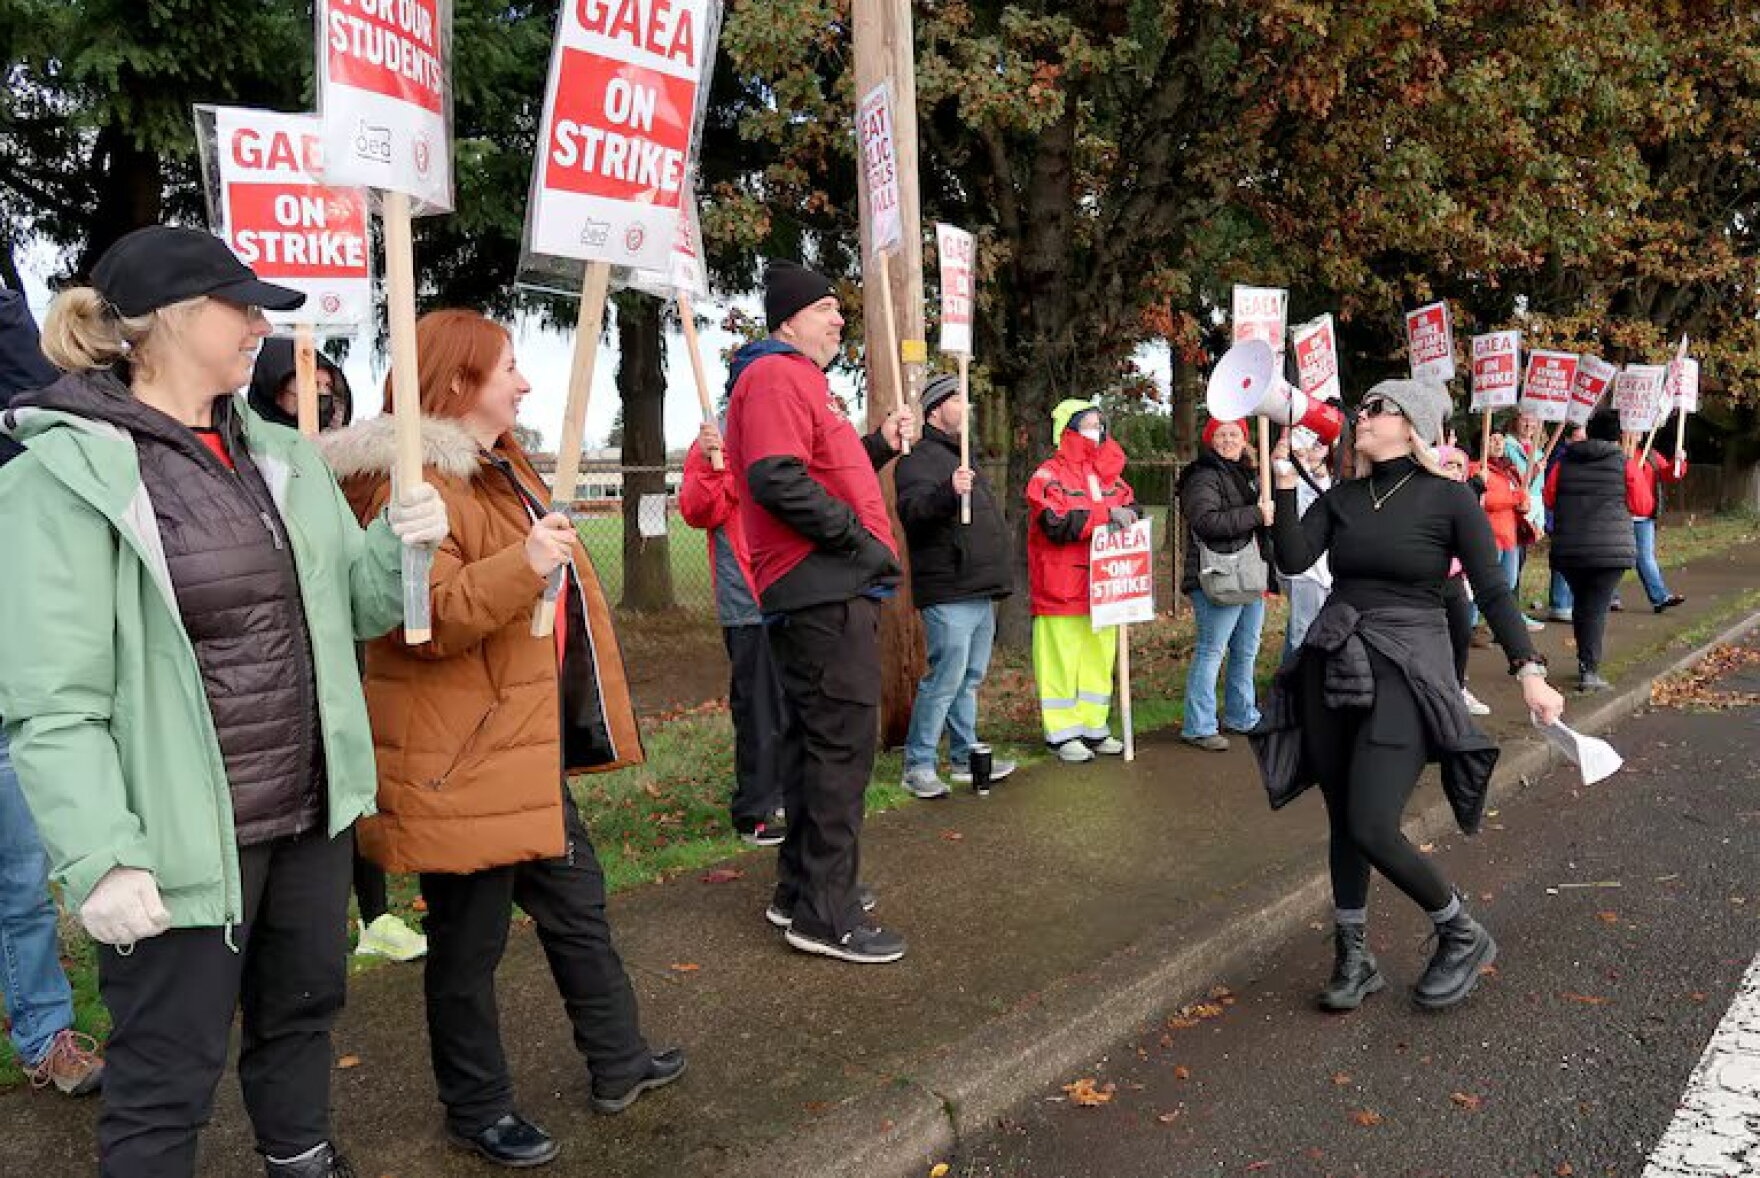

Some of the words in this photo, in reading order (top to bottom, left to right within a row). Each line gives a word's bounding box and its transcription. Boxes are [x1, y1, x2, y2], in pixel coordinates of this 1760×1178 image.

[329, 9, 442, 95] STUDENTS
[575, 0, 695, 68] GAEA
[604, 77, 656, 132] ON
[231, 127, 325, 172] GAE
[552, 119, 684, 192] STRIKE
[274, 194, 326, 228] ON
[233, 231, 366, 268] STRIKE
[1094, 527, 1147, 552] GAEA
[1093, 575, 1149, 598] STRIKE
[1108, 559, 1131, 578] ON
